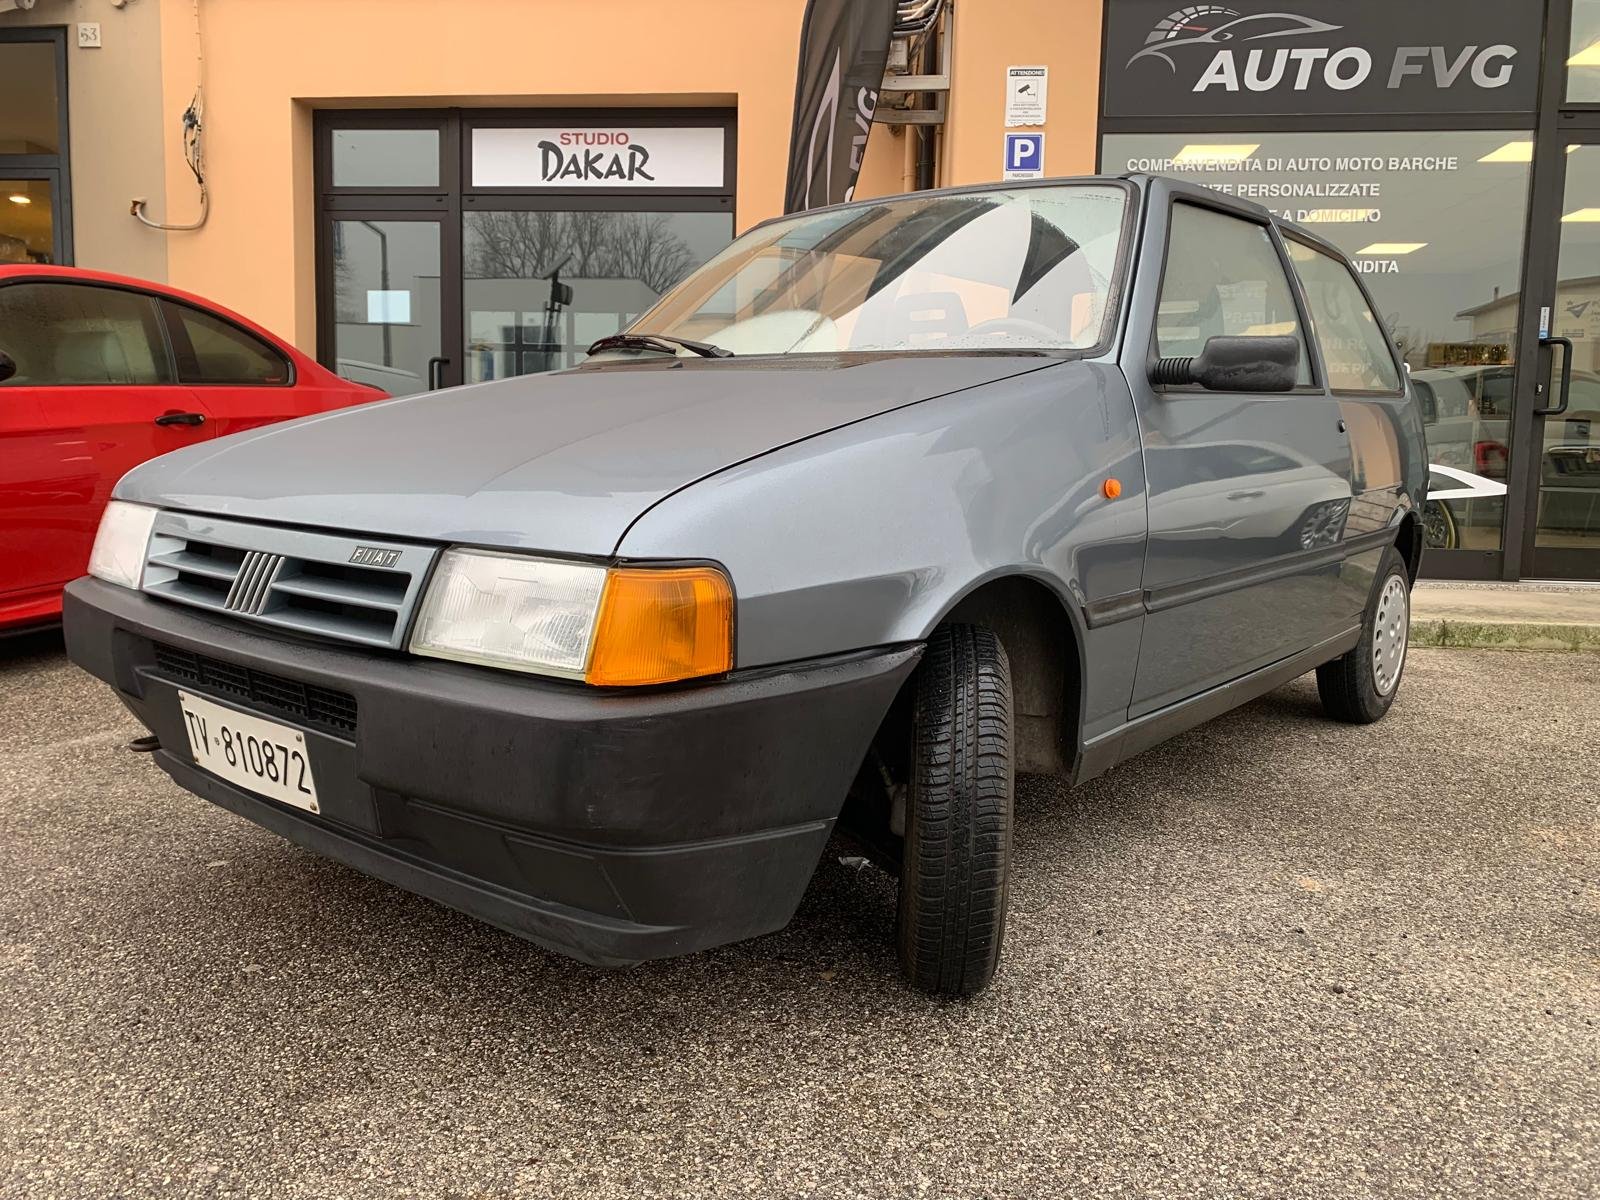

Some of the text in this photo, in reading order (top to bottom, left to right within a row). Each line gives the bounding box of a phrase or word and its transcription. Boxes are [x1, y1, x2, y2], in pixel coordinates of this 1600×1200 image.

[1192, 44, 1518, 91] AUTO FVG
[560, 132, 630, 146] STUDIO
[537, 140, 655, 182] DAKAR
[1013, 138, 1035, 167] P
[1126, 156, 1458, 172] COMPRAVENDITA DI AUTO MOTO BARCHE
[1237, 183, 1380, 197] PERSONALIZZATE
[1296, 208, 1381, 222] DOMICILIO
[1352, 260, 1400, 274] NDITA
[352, 548, 398, 566] FIAT
[184, 709, 312, 795] TV 810872
